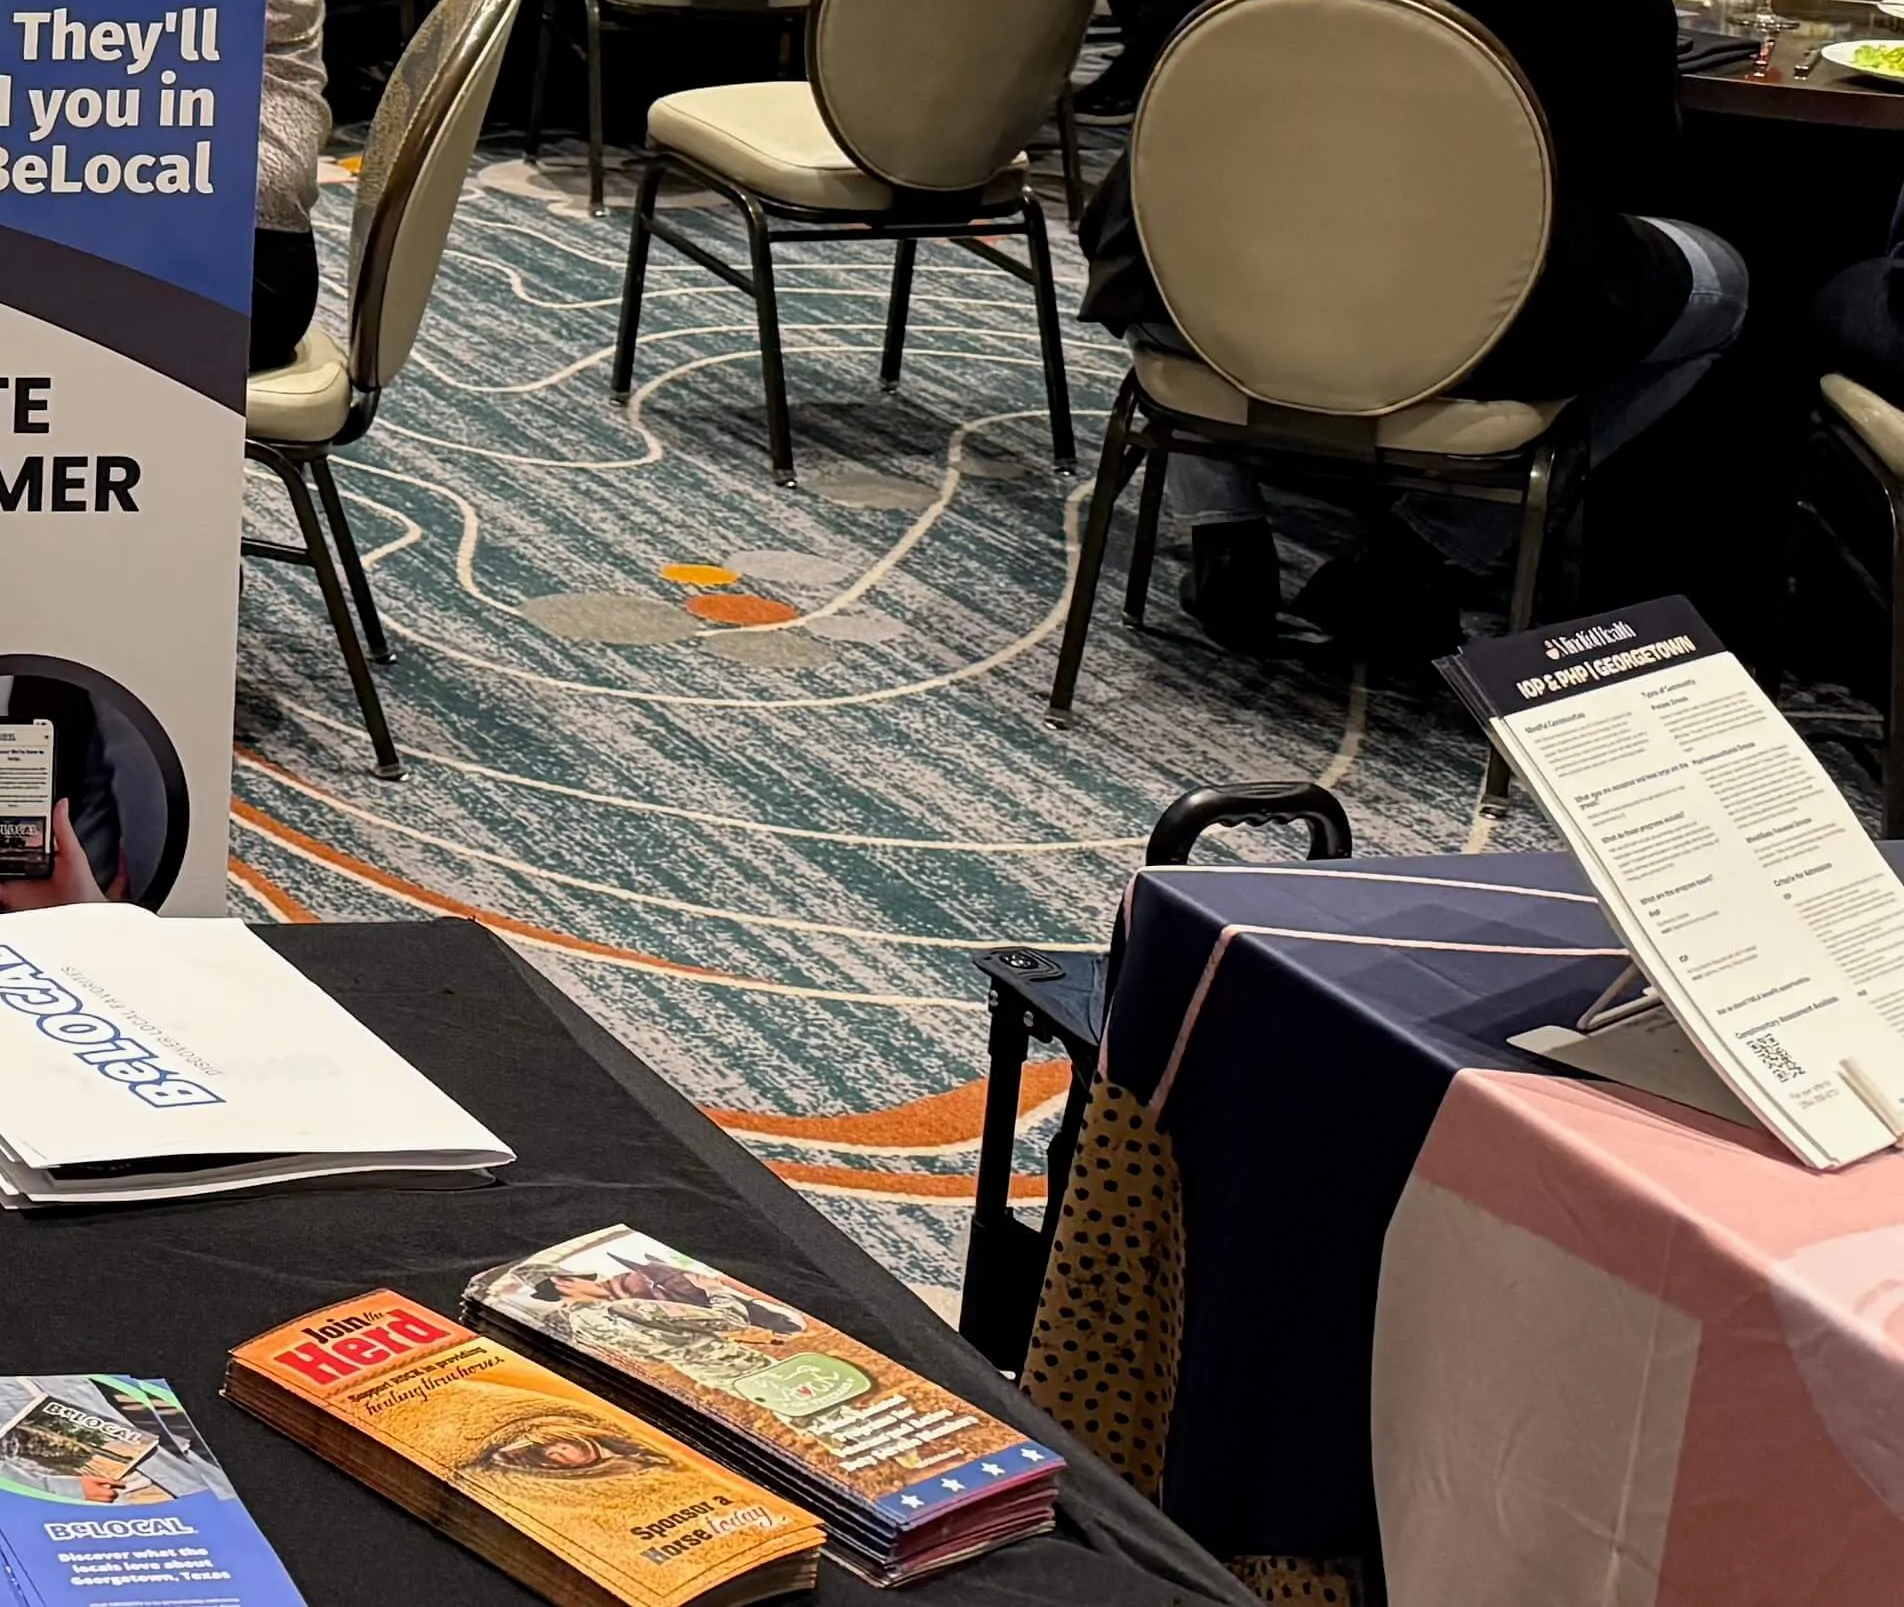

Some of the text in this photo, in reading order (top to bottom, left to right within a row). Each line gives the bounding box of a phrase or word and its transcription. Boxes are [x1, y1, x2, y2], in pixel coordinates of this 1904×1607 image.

[13, 8, 220, 63] They'll
[30, 86, 142, 141] you
[159, 84, 215, 128] in
[1516, 635, 1697, 699] IOP & PHP GEORGETOWN
[274, 1309, 452, 1386] Herd
[302, 1312, 371, 1344] Join
[630, 1495, 734, 1541] Sponsor a
[640, 1528, 713, 1566] Horse
